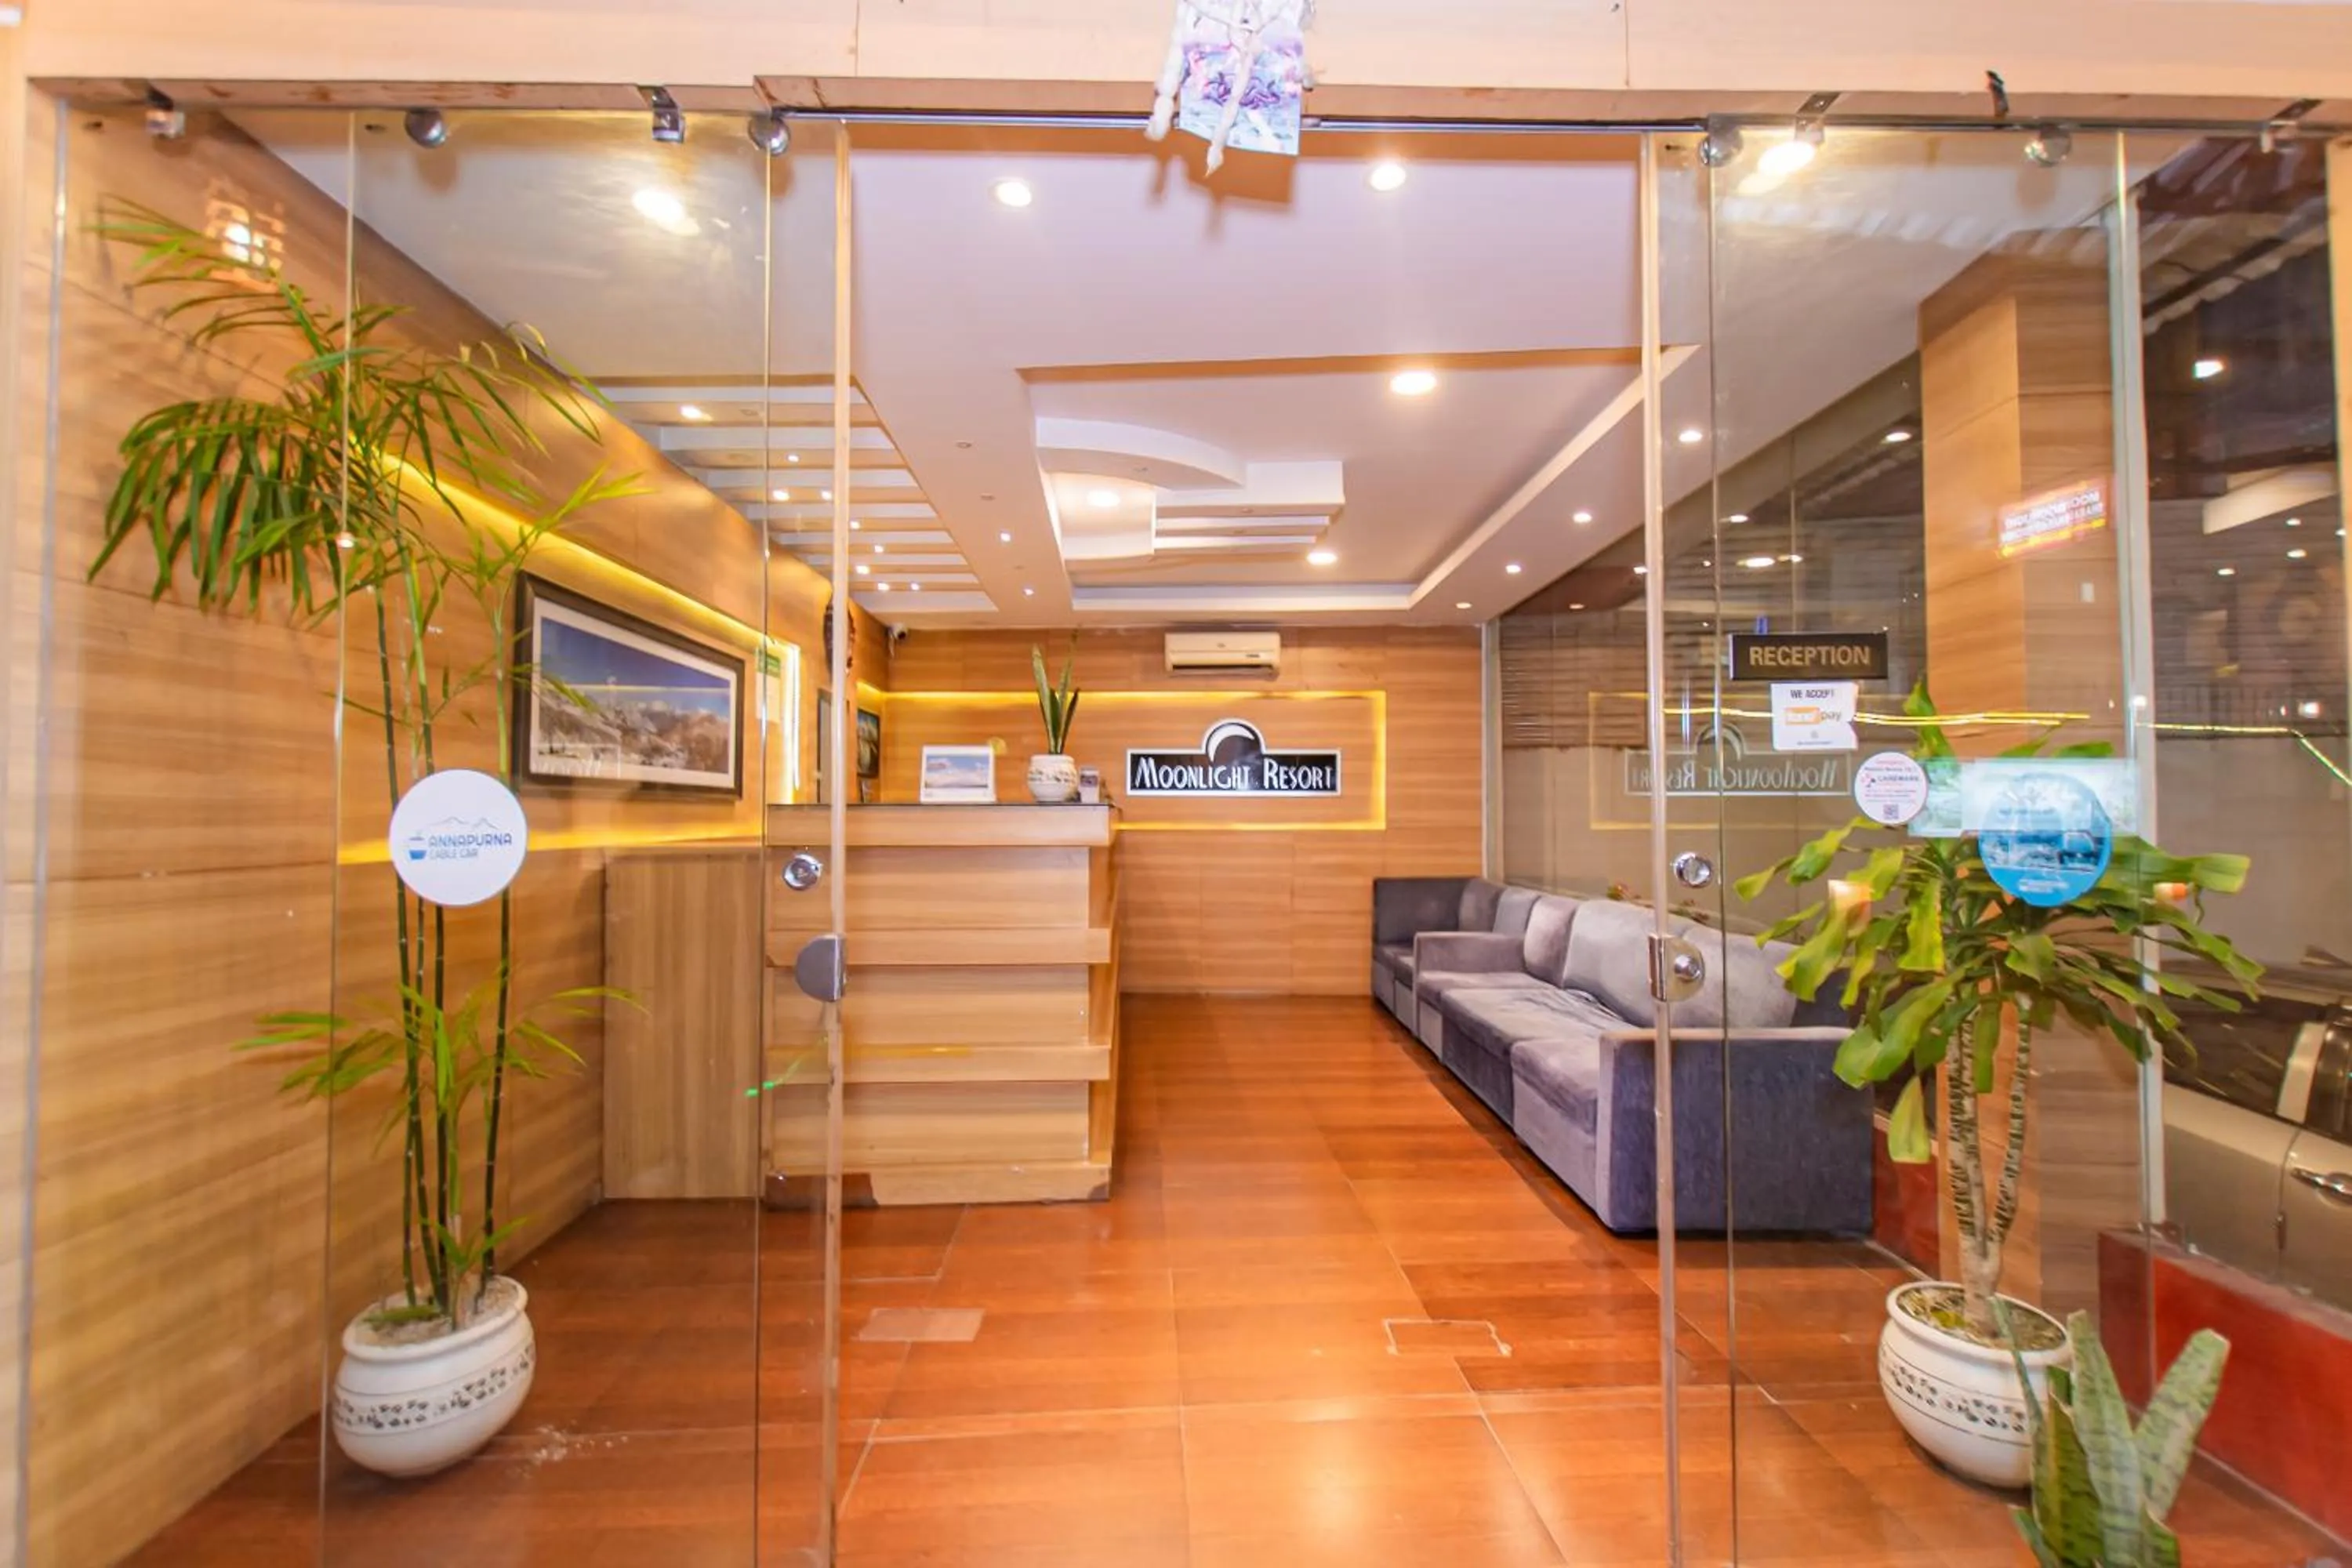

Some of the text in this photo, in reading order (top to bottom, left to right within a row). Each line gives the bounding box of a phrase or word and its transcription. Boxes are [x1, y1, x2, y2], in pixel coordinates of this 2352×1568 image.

[1748, 645, 1871, 666] RECEPTION
[1790, 689, 1802, 699] WE
[428, 833, 513, 848] ANNAPURNA
